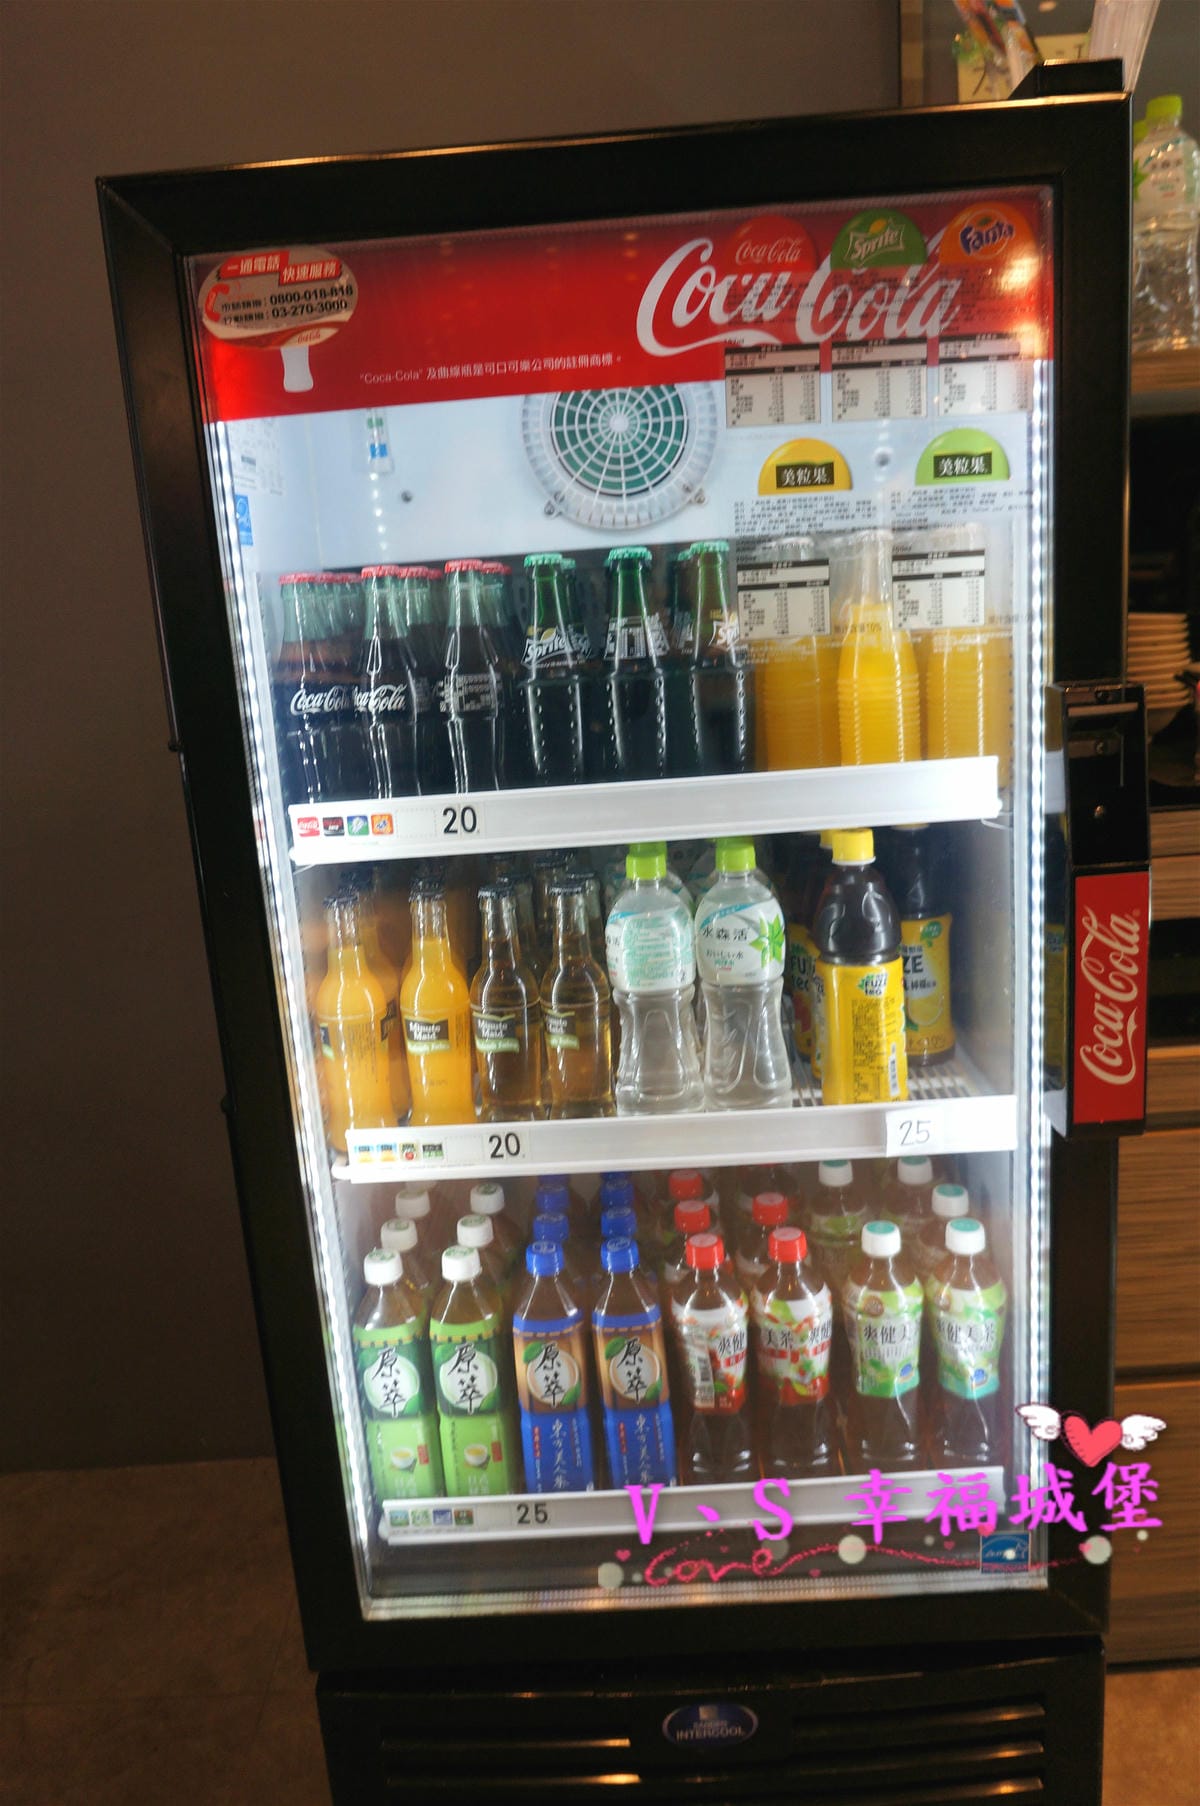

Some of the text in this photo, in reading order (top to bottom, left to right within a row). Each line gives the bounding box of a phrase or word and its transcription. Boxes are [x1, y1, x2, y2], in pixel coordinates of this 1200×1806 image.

[851, 230, 902, 262] Sprite
[960, 219, 1014, 256] Fanta
[227, 254, 281, 275] 一通電話
[736, 238, 801, 266] Coca-Cola
[283, 260, 337, 283] 快速服務
[781, 467, 831, 487] 美粒果
[938, 455, 988, 476] 美粒果
[442, 806, 477, 835] 20
[1079, 903, 1141, 1086] Coca-Cola
[409, 1020, 441, 1033] Minute
[413, 1030, 438, 1041] Maid
[477, 1019, 508, 1031] Minute
[481, 1028, 505, 1040] Maid
[488, 1132, 521, 1160] 20
[898, 1119, 932, 1147] 25
[370, 1345, 407, 1420] 原萃
[447, 1341, 484, 1416] 原萃
[533, 1341, 568, 1409] 原萃
[615, 1335, 649, 1405] 原萃
[516, 1503, 549, 1525] 25
